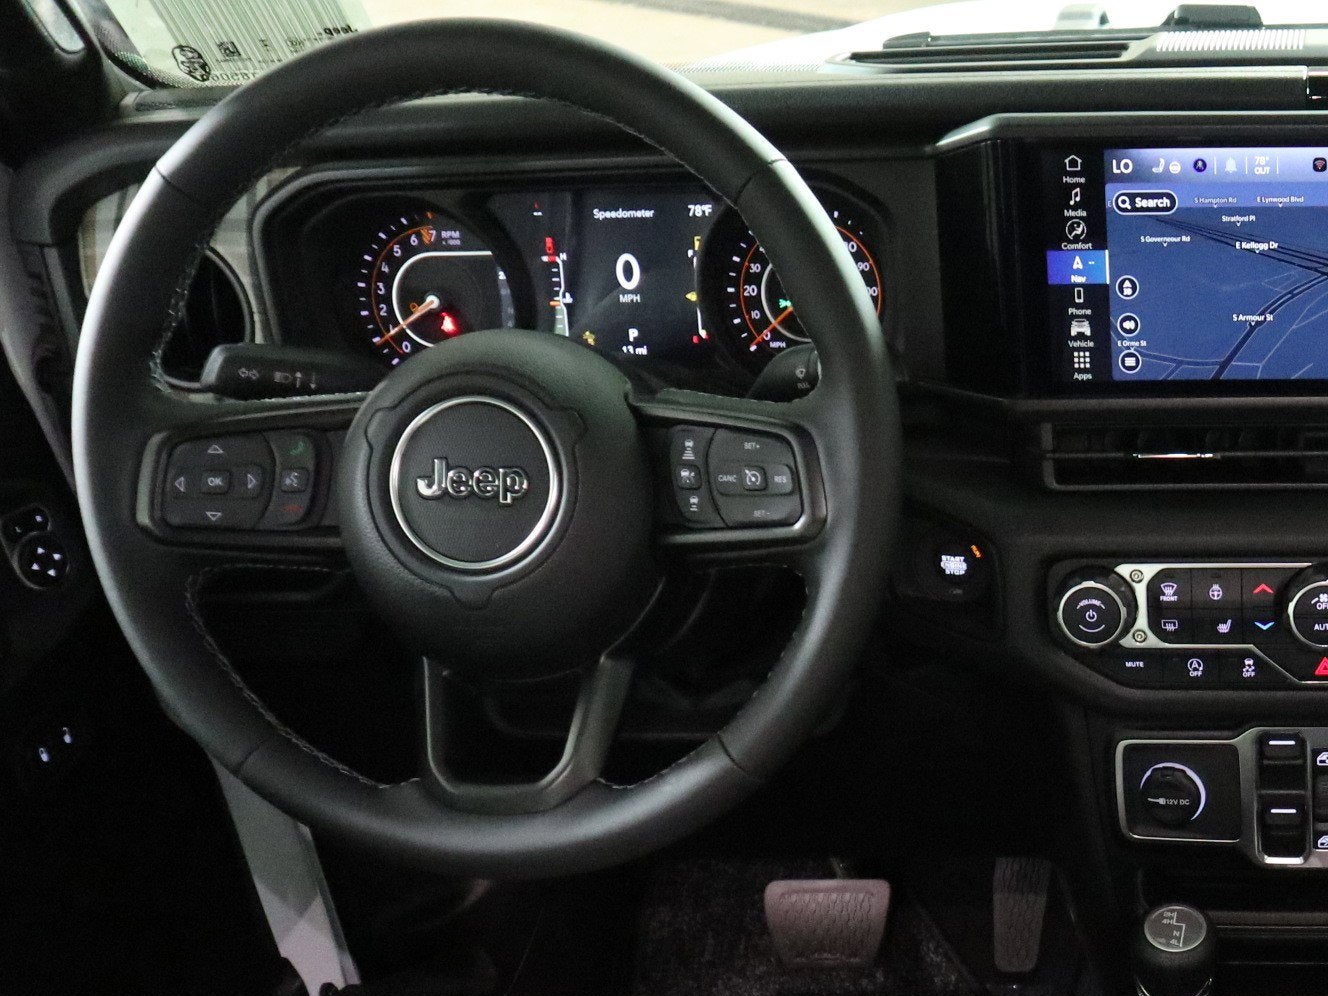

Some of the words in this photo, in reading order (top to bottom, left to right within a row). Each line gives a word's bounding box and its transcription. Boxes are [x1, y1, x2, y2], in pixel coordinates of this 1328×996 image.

[1112, 159, 1133, 174] LO
[1254, 167, 1270, 175] OUT
[1135, 197, 1170, 208] Search
[1200, 197, 1227, 205] Hampton
[1262, 196, 1289, 204] Lynwood
[593, 208, 654, 220] Speedometer
[410, 234, 418, 246] 6
[429, 230, 436, 242] 7
[393, 245, 401, 257] 5
[1061, 242, 1093, 250] Comfort
[1242, 241, 1269, 251] Kellogg
[1269, 241, 1278, 249] Dr
[381, 262, 389, 273] 4
[616, 252, 641, 290] 0
[750, 263, 761, 273] 30
[1071, 275, 1086, 283] Nav
[377, 282, 385, 295] 3
[743, 285, 758, 296] 20
[619, 294, 641, 303] MPH
[379, 304, 387, 316] 2
[751, 310, 760, 319] 10
[1068, 307, 1092, 315] Phone
[1238, 314, 1263, 322] Armour
[1264, 314, 1274, 322] St
[628, 328, 639, 342] P
[402, 341, 411, 353] 0
[769, 341, 786, 349] MPH
[1068, 340, 1094, 348] Vehicle
[1073, 372, 1092, 381] Apps
[207, 477, 222, 486] OK
[416, 457, 529, 505] Jeep
[774, 475, 787, 483] RES
